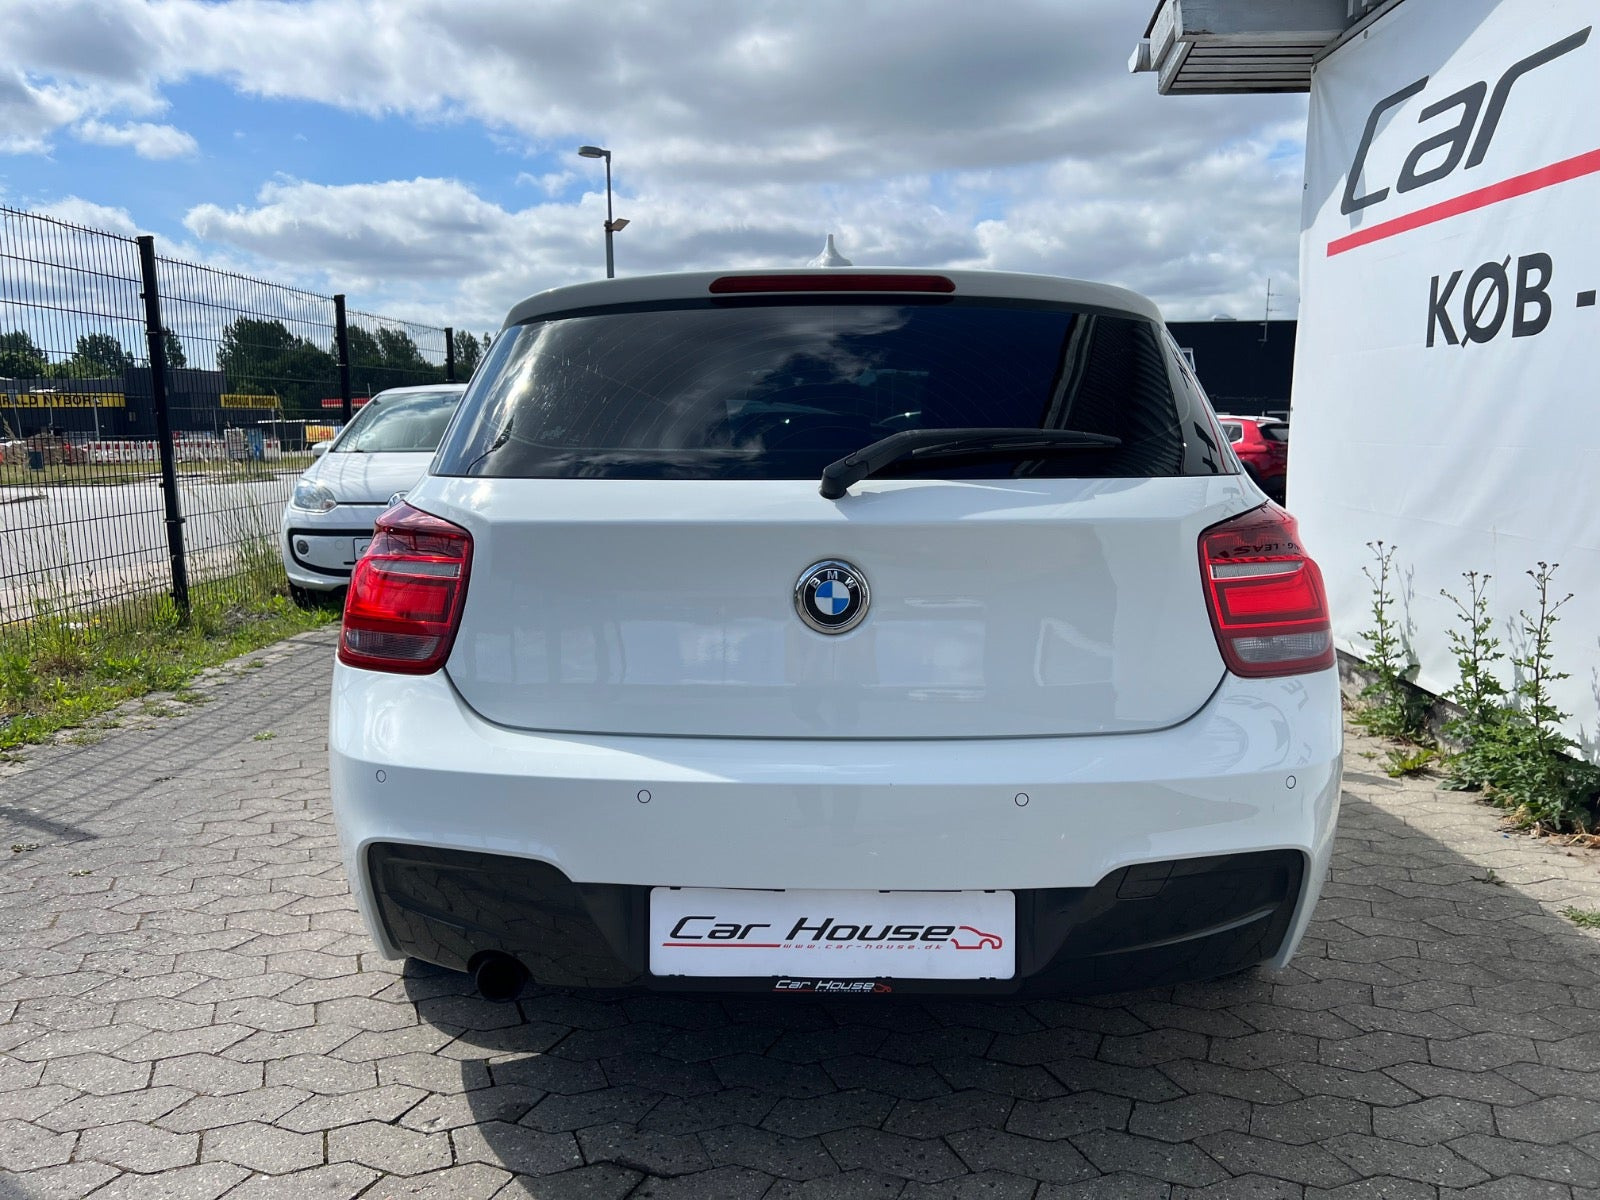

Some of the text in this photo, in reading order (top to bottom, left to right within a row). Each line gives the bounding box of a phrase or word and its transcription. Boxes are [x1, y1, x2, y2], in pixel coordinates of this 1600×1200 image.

[1340, 25, 1593, 216] Car
[1426, 252, 1553, 349] KØB
[810, 571, 857, 589] BMW
[669, 915, 956, 942] Car House
[782, 943, 943, 951] www.car-house.dk
[775, 979, 875, 990] Car House
